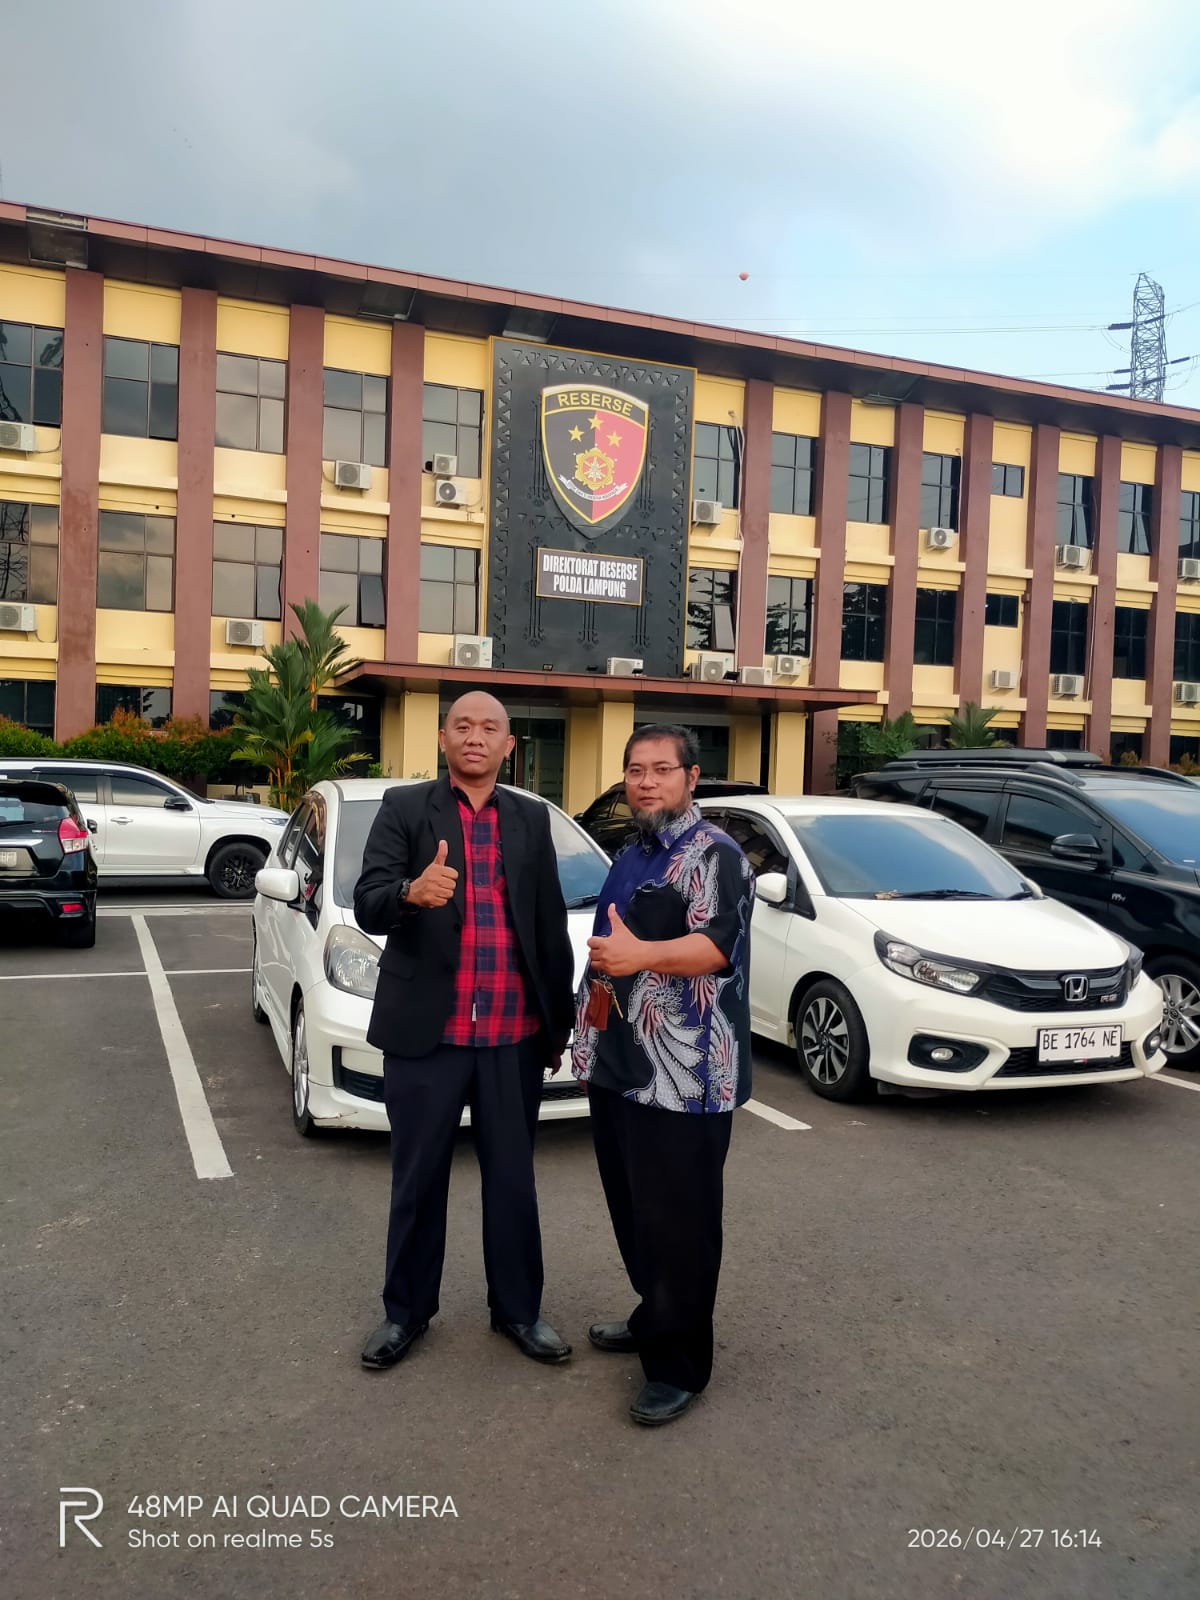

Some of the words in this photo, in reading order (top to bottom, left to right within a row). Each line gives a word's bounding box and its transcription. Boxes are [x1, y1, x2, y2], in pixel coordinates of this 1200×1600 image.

[557, 392, 633, 417] RESERSE
[543, 554, 599, 577] DIREKTORAT
[600, 560, 638, 581] RESERSE
[553, 574, 583, 594] POLDA
[583, 577, 626, 598] LAMPUNG
[1043, 1033, 1058, 1050] BE
[1064, 1031, 1096, 1049] 1764
[1103, 1030, 1118, 1046] NE
